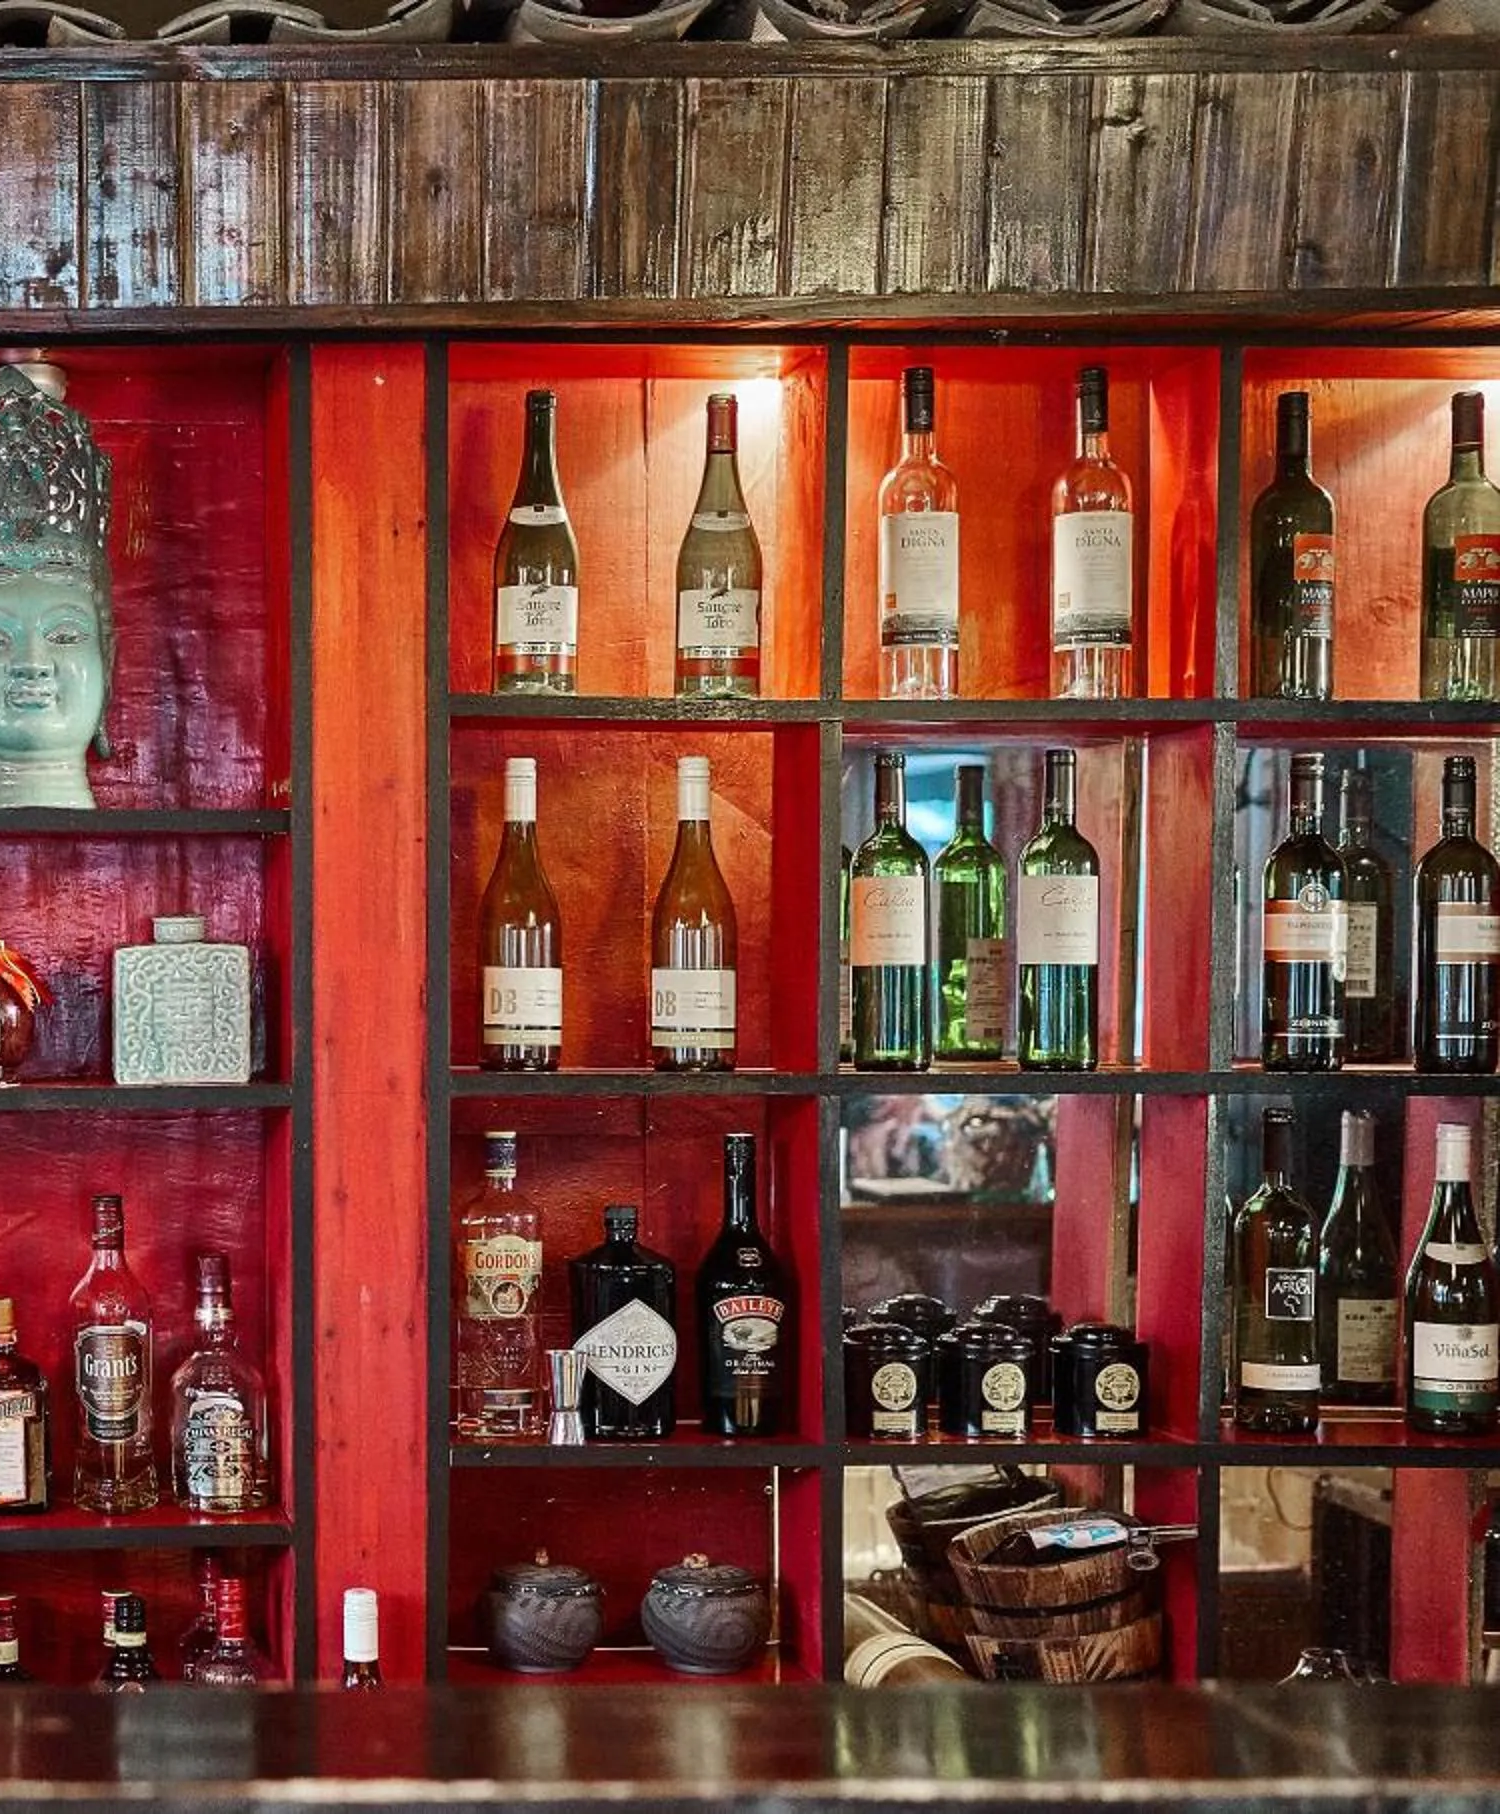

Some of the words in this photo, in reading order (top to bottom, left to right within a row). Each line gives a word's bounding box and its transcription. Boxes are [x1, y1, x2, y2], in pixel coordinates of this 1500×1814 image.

[491, 987, 518, 1016] DB
[718, 1299, 783, 1318] BAILEYS
[84, 1352, 138, 1378] Grant's
[623, 1364, 652, 1375] GIN
